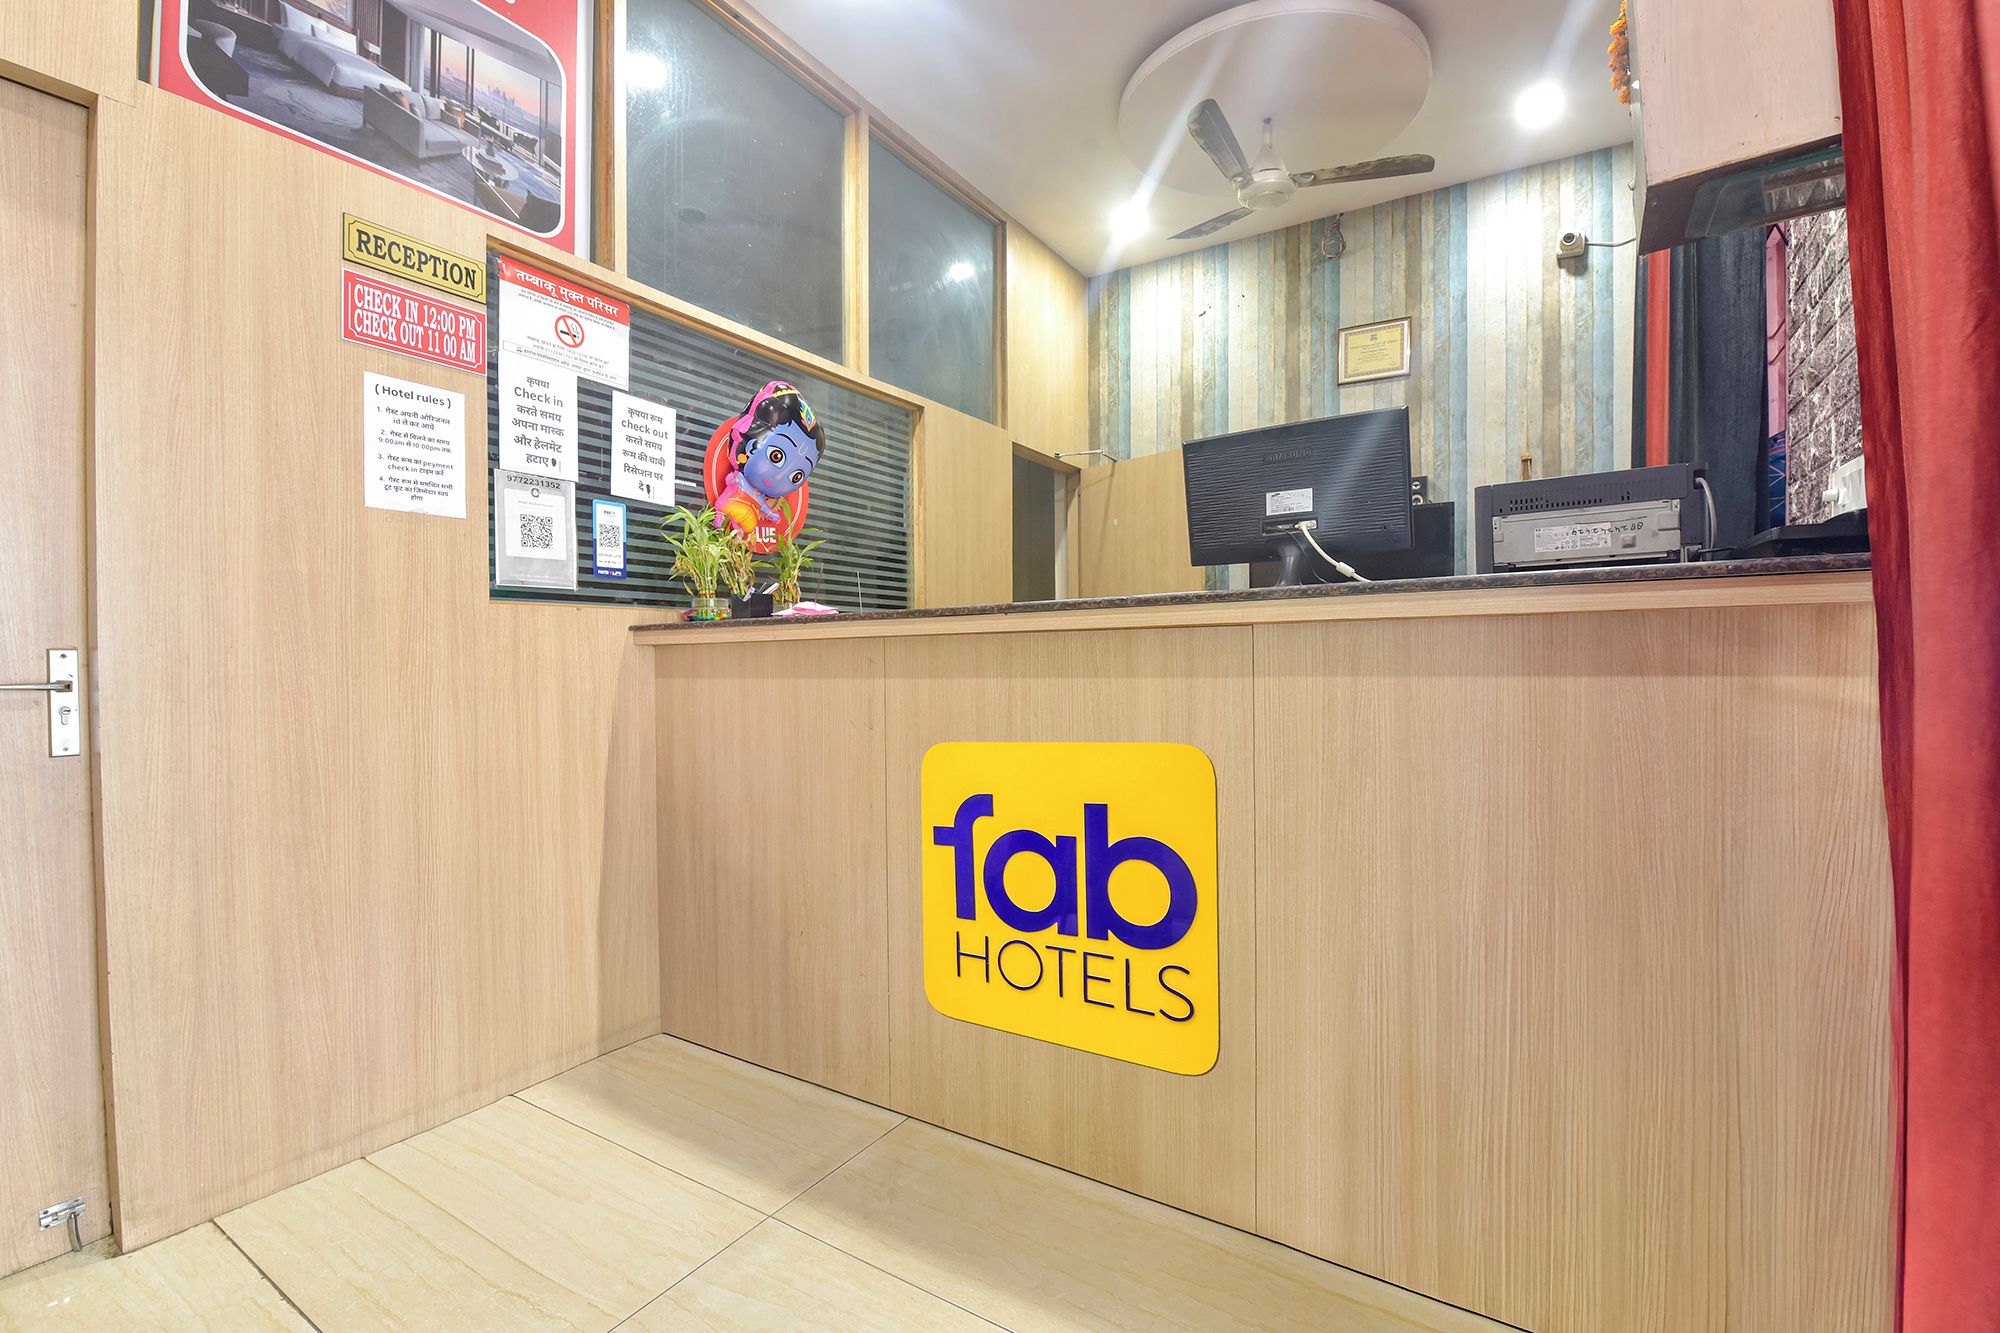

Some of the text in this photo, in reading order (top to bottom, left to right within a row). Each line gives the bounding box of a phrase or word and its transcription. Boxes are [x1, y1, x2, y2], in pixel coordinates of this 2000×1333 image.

[356, 229, 476, 290] RECEPTION
[515, 269, 558, 298] तम्बाकू
[558, 285, 584, 304] मुक्त
[586, 296, 619, 317] परिसर
[354, 283, 476, 340] CHECK IN 12:00 PM
[354, 308, 476, 363] CHECK OUT 11 00 AM
[526, 376, 549, 389] कृपया
[382, 386, 414, 400] Hotel
[416, 394, 445, 406] rules
[514, 386, 563, 407] Check in
[400, 410, 418, 419] अपनी
[516, 404, 561, 422] करते समय
[627, 407, 648, 420] कृपया
[512, 417, 565, 437] अपना मास्क
[621, 419, 668, 440] check out
[514, 434, 562, 453] और हेलमेट
[625, 434, 663, 451] करते समय
[526, 453, 549, 467] हटाए
[638, 451, 648, 463] की
[388, 464, 409, 472] check
[654, 472, 664, 481] पर
[506, 475, 561, 490] 9772231352
[933, 793, 1198, 950] fab
[955, 931, 1195, 1022] HOTELS
